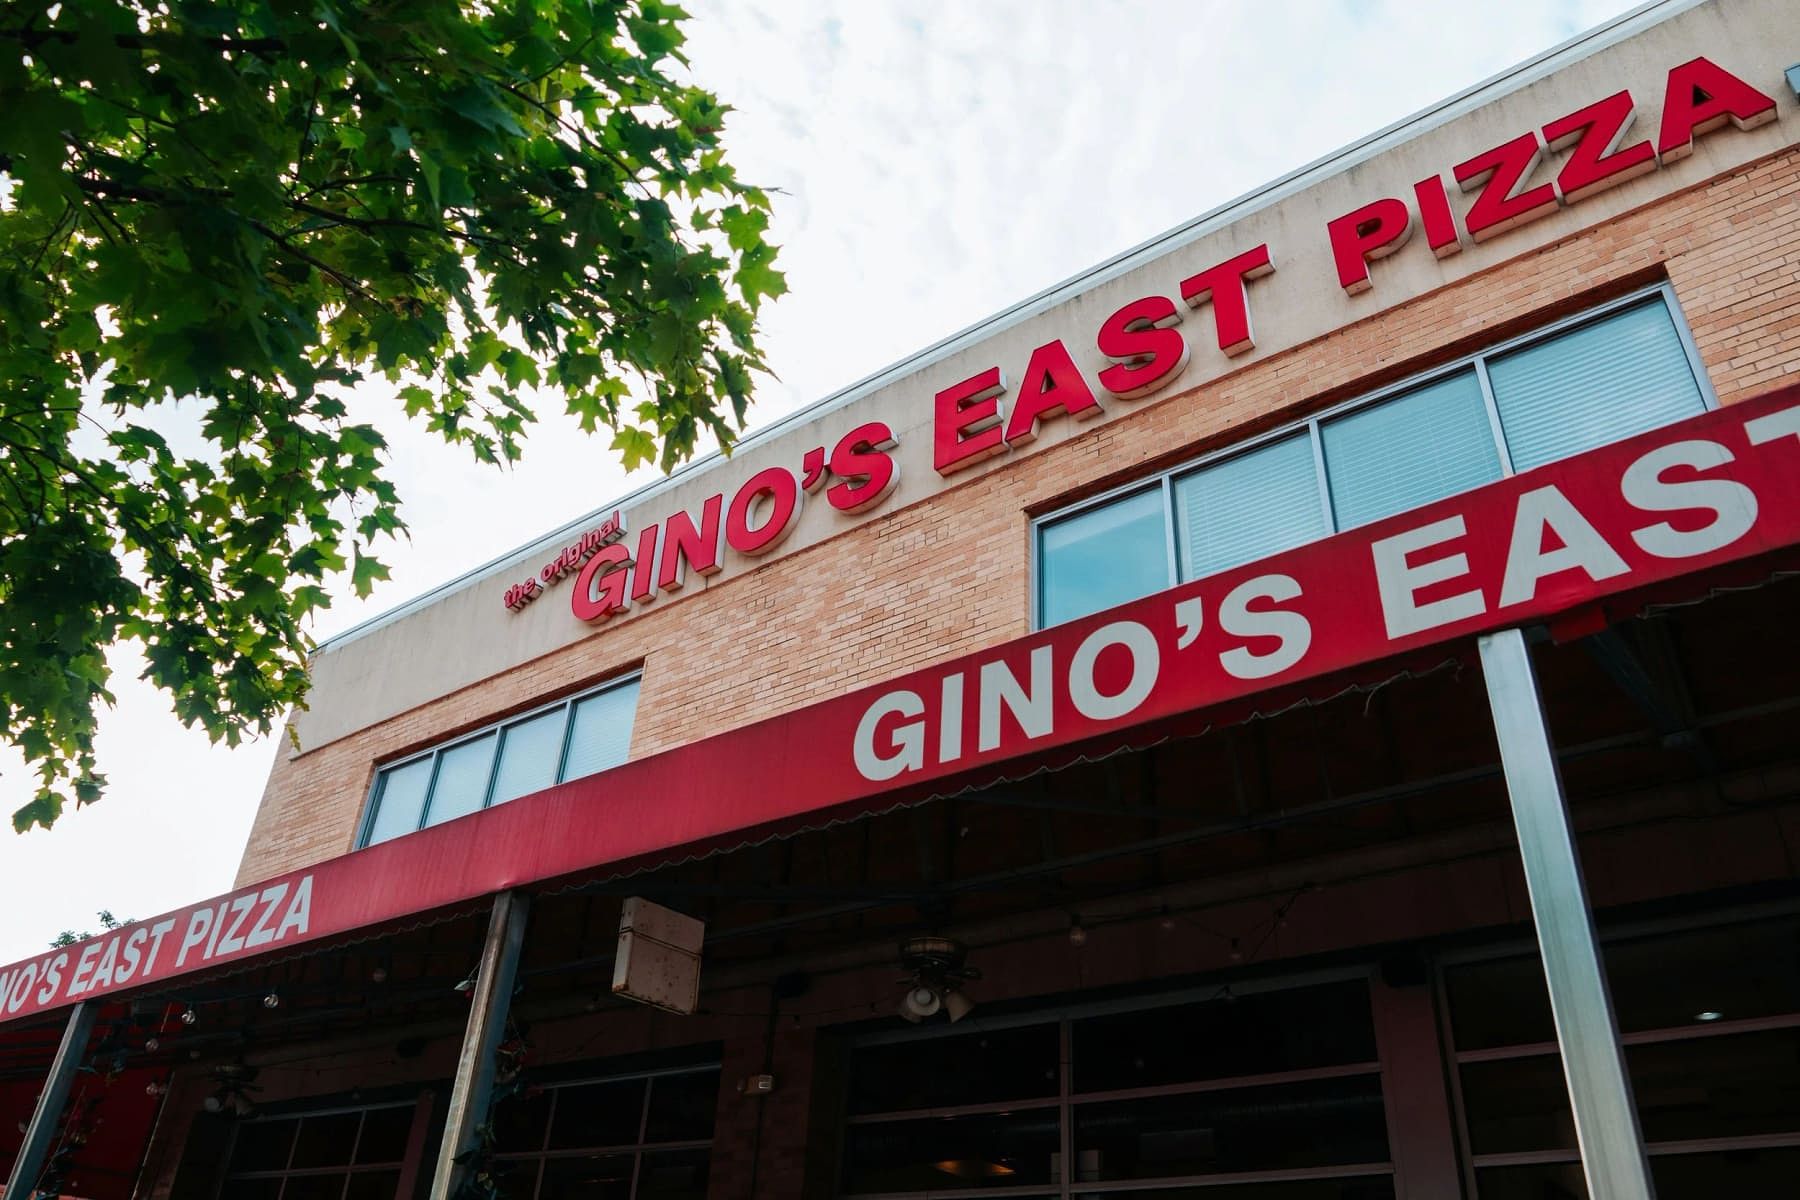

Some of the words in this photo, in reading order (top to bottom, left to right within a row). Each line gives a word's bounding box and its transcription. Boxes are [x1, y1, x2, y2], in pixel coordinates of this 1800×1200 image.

[571, 421, 895, 622] GINO'S
[933, 242, 1271, 472] EAST
[1327, 56, 1778, 293] PIZZA
[504, 577, 537, 609] the
[540, 510, 622, 583] original
[853, 573, 1312, 782] GINO'S
[66, 918, 177, 998] EAST
[176, 875, 314, 968] PIZZA
